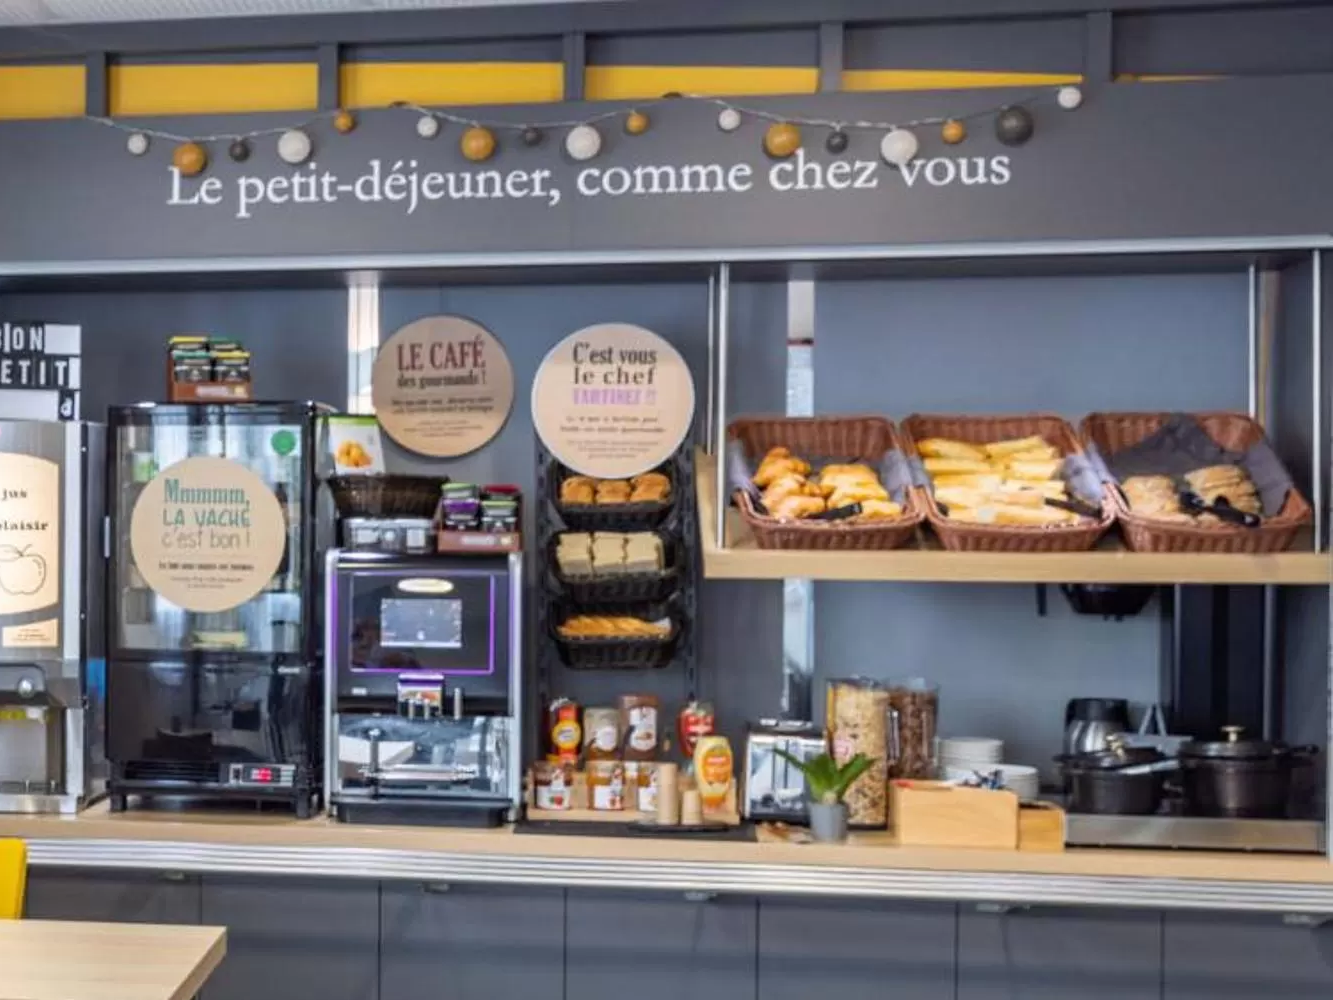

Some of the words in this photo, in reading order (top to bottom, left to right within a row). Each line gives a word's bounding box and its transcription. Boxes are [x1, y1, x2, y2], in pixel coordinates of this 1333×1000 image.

[167, 165, 223, 205] Le
[236, 159, 561, 218] petit-déjeuner,
[576, 161, 753, 197] comme
[768, 147, 878, 191] chez
[898, 155, 1011, 186] vous
[397, 343, 424, 371] LE
[430, 333, 486, 370] CAFÉ
[619, 348, 658, 365] vous
[573, 367, 595, 385] le
[603, 365, 656, 385] chef
[162, 508, 185, 527] LA
[194, 507, 252, 528] VACHE
[209, 529, 241, 549] bon
